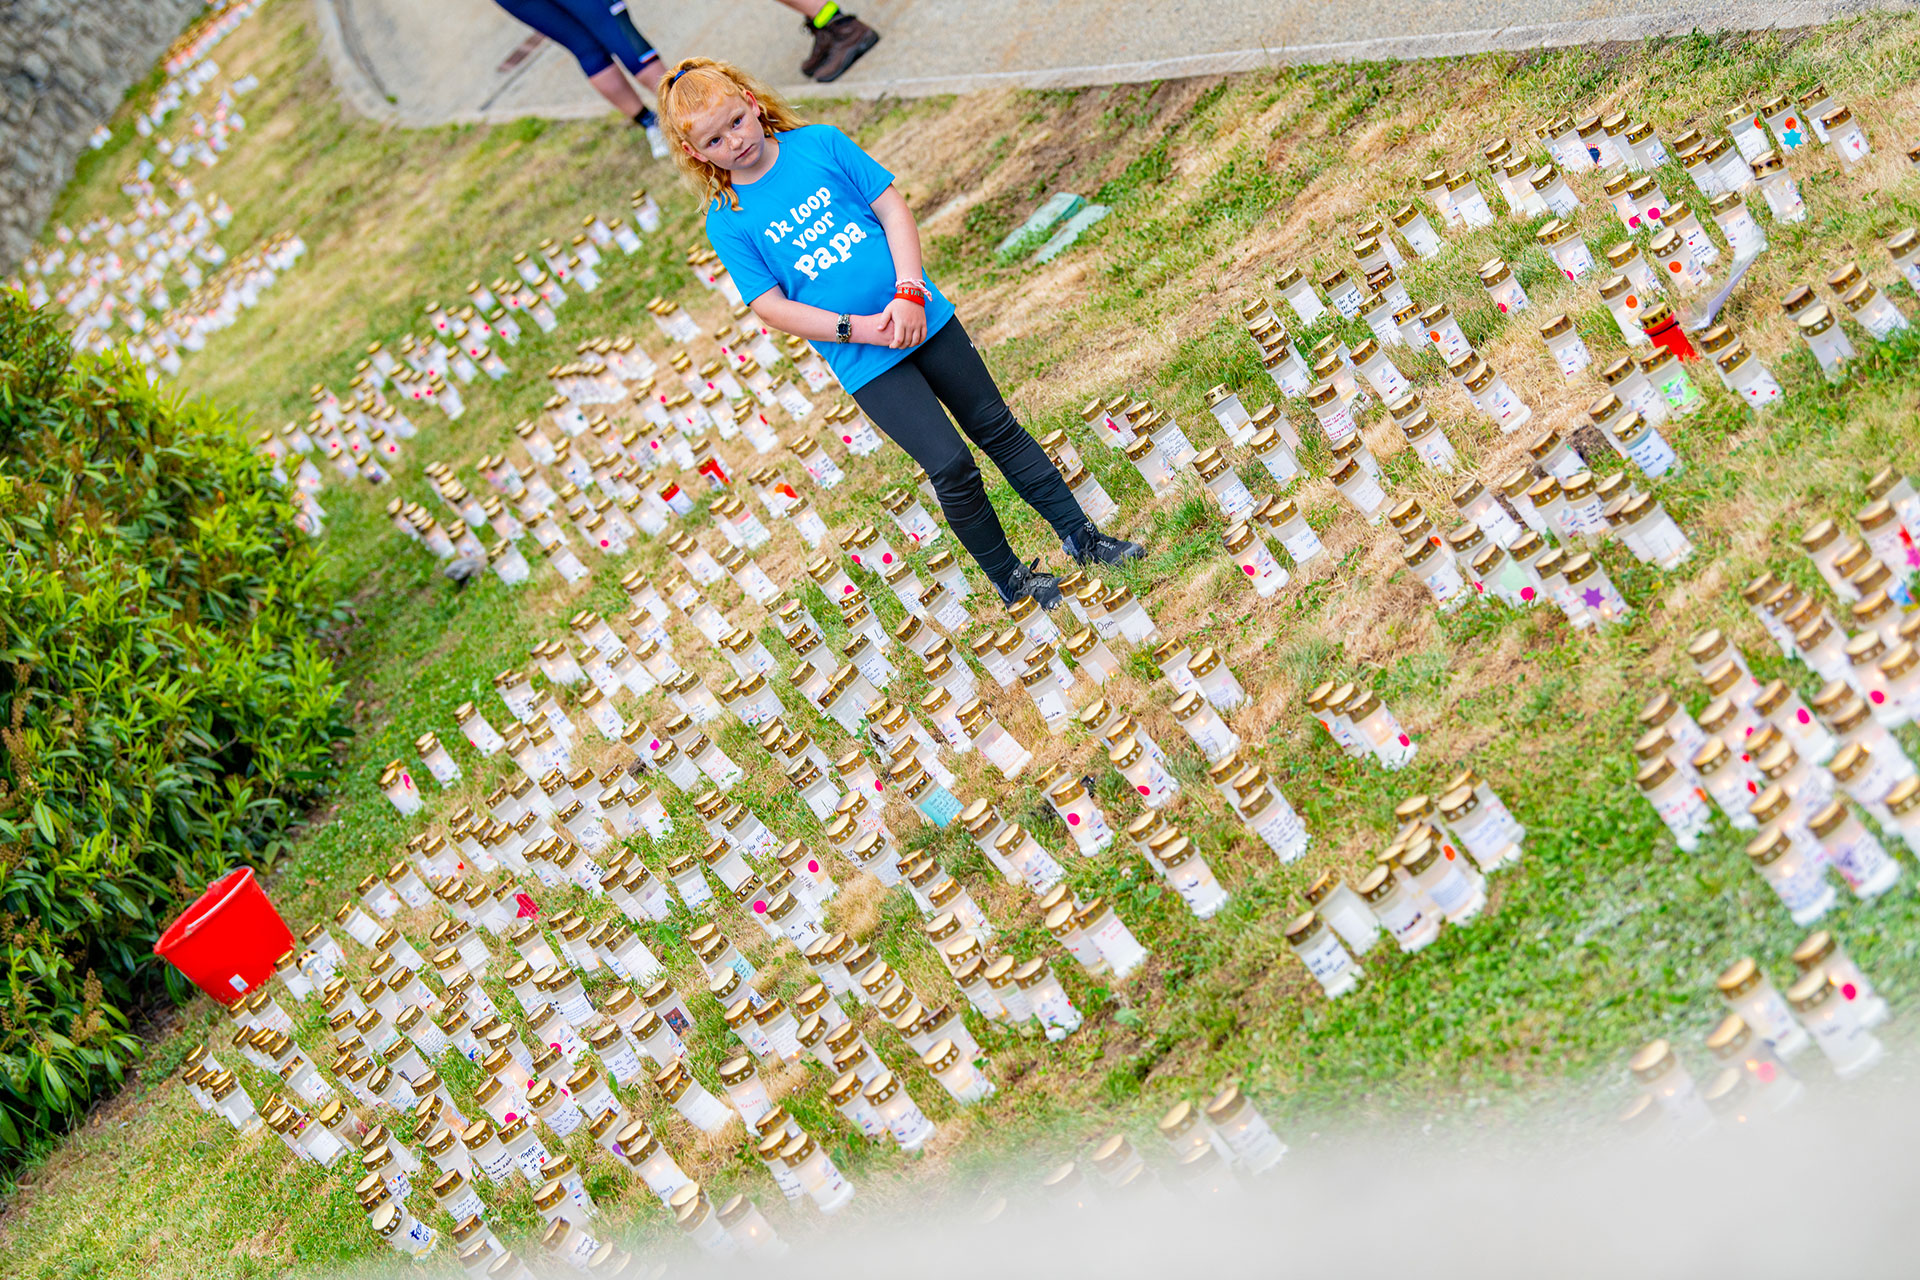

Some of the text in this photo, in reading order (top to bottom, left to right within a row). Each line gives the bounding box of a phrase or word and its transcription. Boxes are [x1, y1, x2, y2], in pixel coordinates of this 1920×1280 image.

[764, 187, 831, 244] Ik loop
[792, 211, 835, 250] voor
[793, 222, 867, 281] Papa
[1096, 620, 1115, 631] Opa
